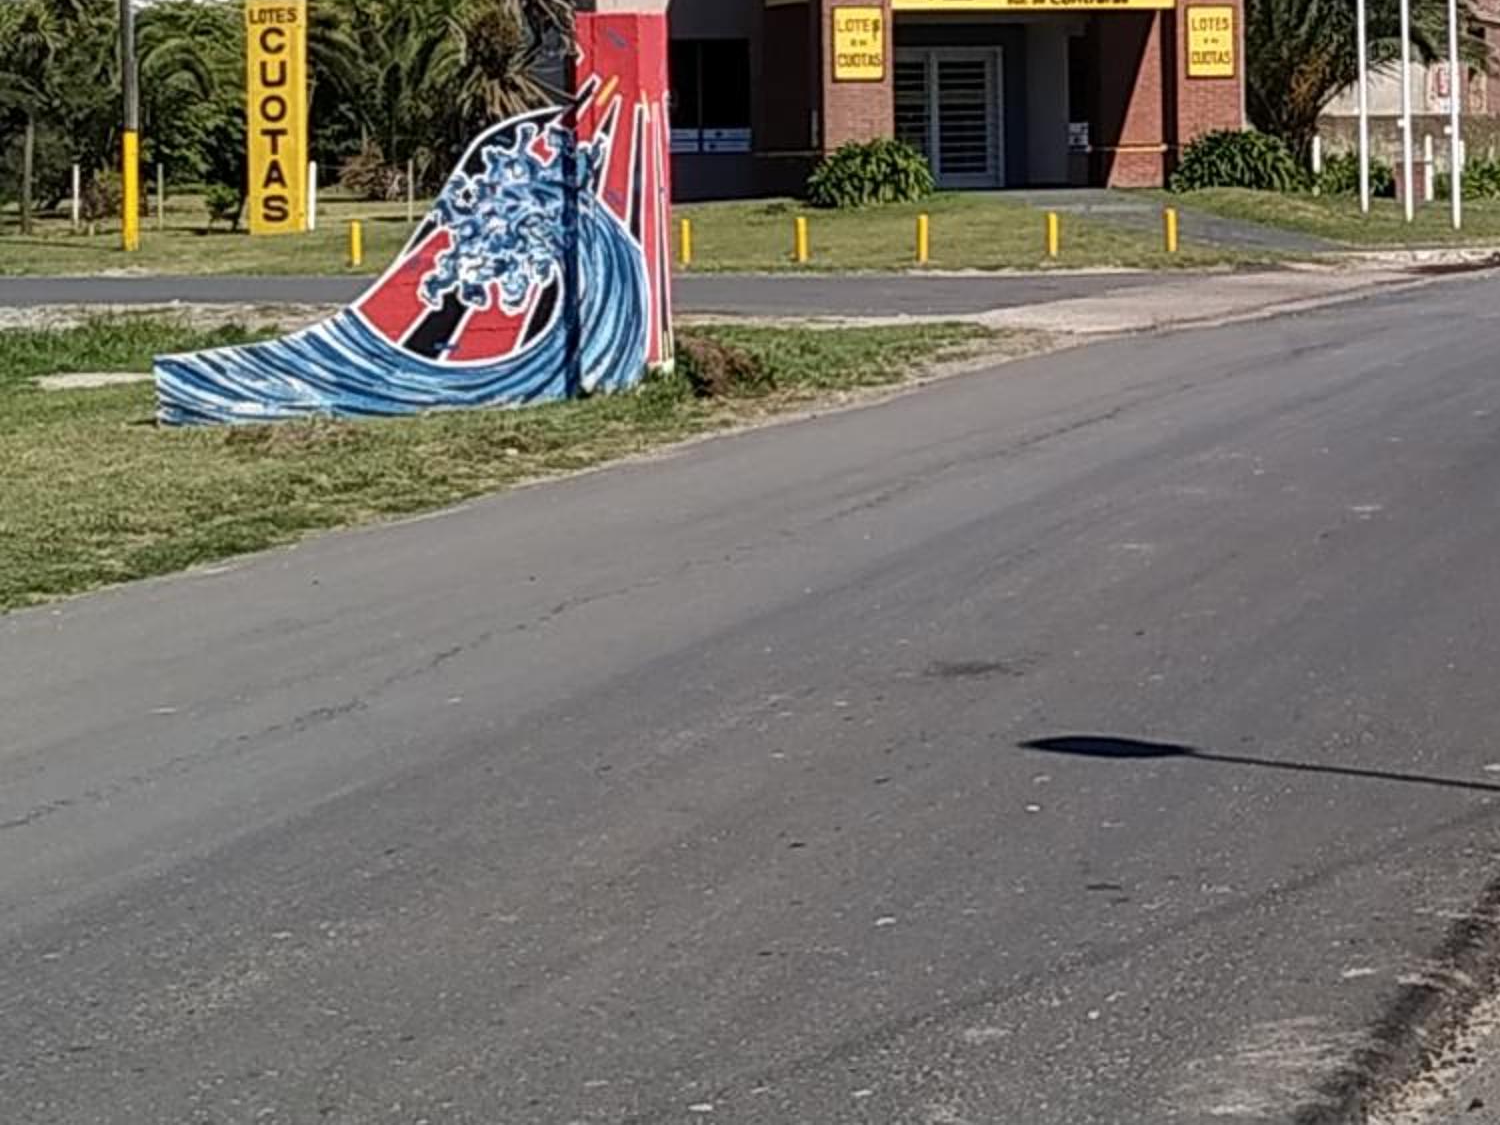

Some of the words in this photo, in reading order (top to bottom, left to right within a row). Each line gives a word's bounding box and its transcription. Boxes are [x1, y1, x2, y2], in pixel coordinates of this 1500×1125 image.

[250, 7, 298, 25] LOTES
[836, 18, 881, 33] LOTES
[1191, 17, 1229, 32] LOTES
[838, 53, 882, 68] CUOTAS
[1191, 50, 1231, 65] CUOTAS
[259, 27, 289, 223] CUOTAS
